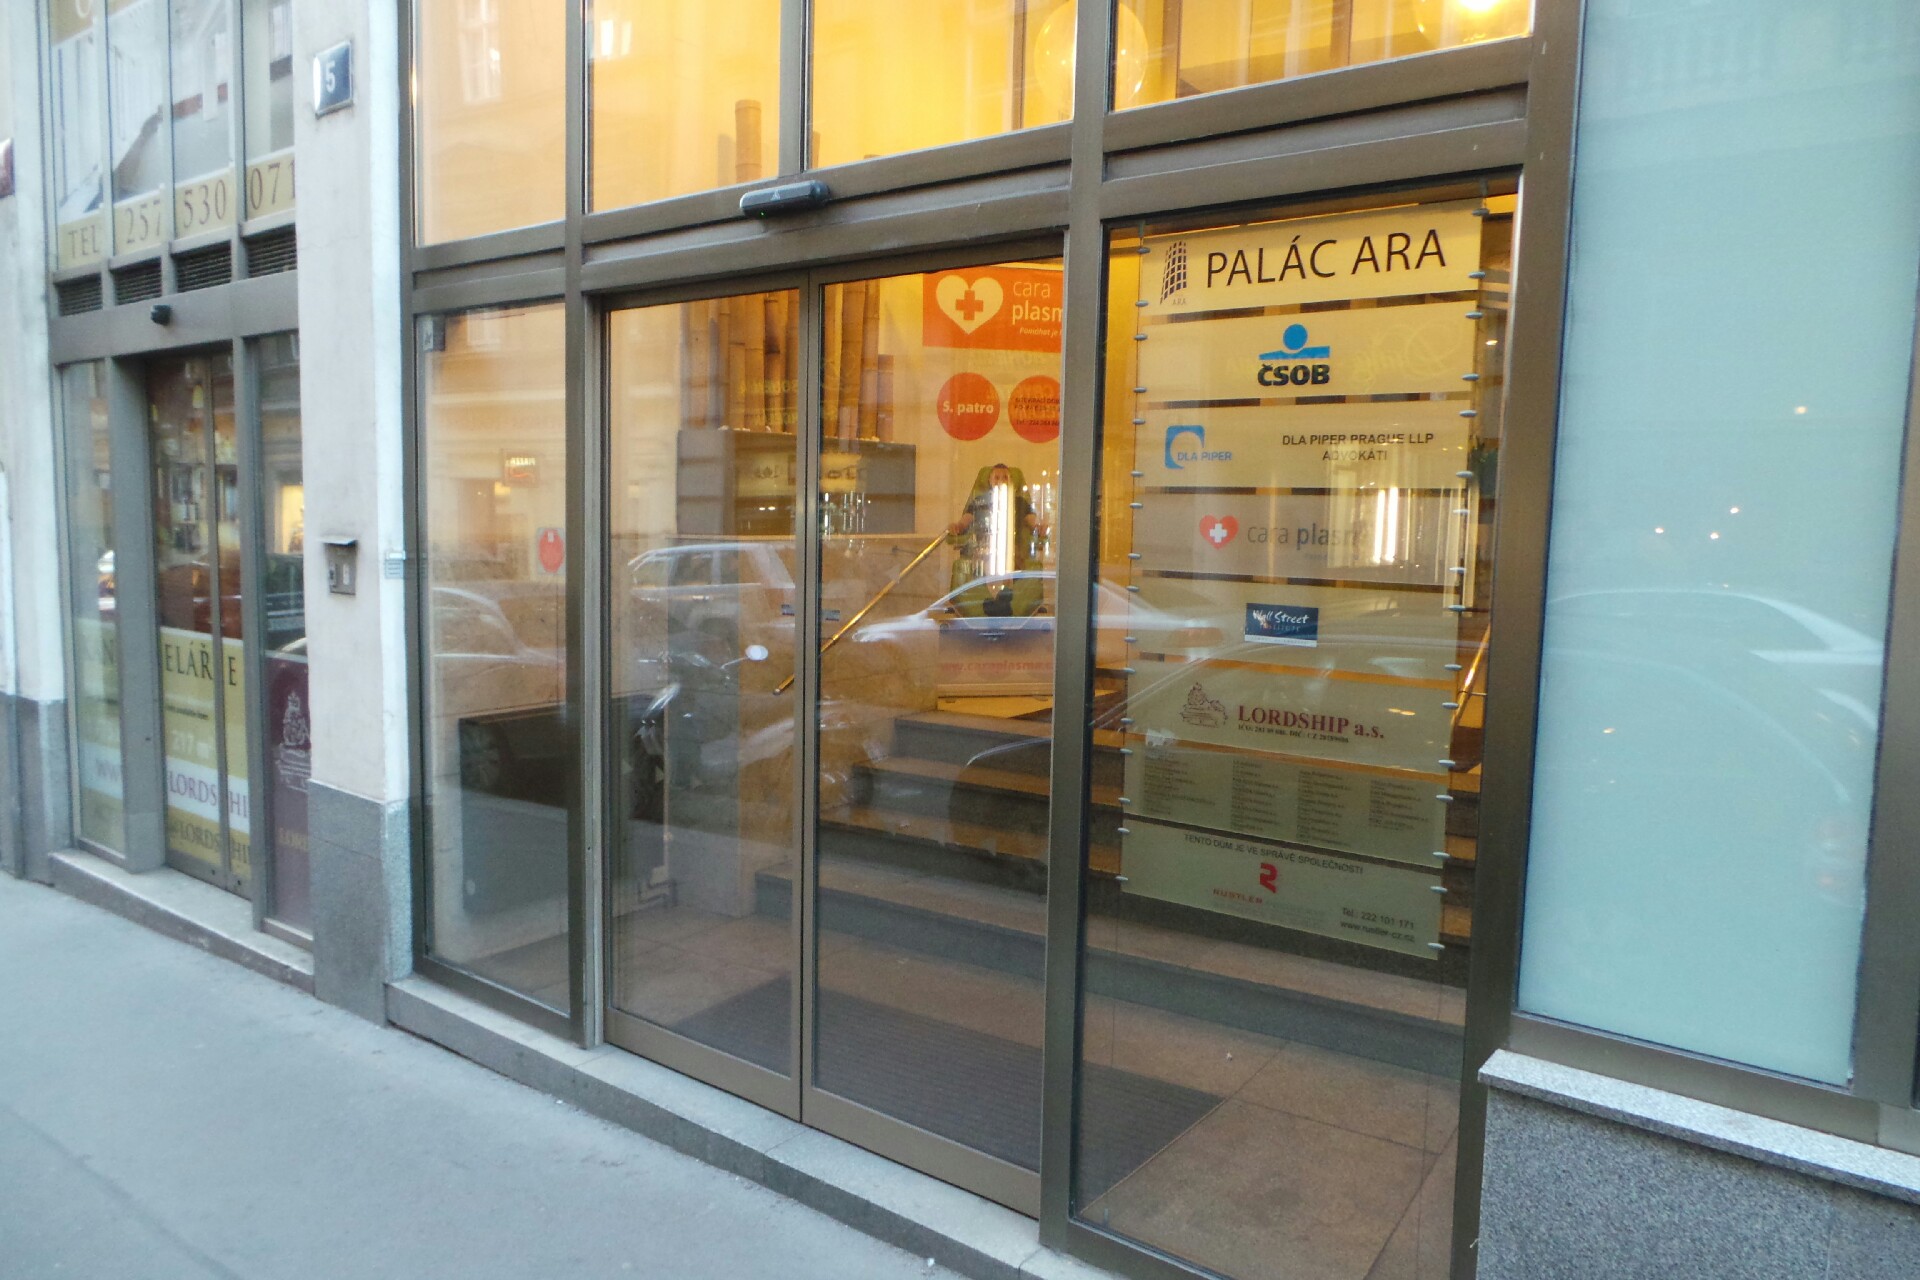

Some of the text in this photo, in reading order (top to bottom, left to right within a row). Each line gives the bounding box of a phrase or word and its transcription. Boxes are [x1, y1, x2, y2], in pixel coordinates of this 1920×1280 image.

[326, 61, 336, 93] 5
[125, 199, 161, 244] 257
[183, 179, 227, 228] 530
[1207, 228, 1446, 288] PALÁC ARA
[1013, 281, 1051, 299] cara
[1257, 363, 1331, 387] ČSOB
[957, 402, 994, 416] patro
[1282, 433, 1434, 445] DLA PIPER PRAGUE LLP
[1177, 451, 1232, 462] DLA PIPER
[1274, 611, 1310, 624] Street
[1238, 705, 1350, 734] LORDSHIP
[1354, 723, 1385, 739] a.s.
[1184, 833, 1211, 846] TENTO
[1361, 911, 1377, 922] 222
